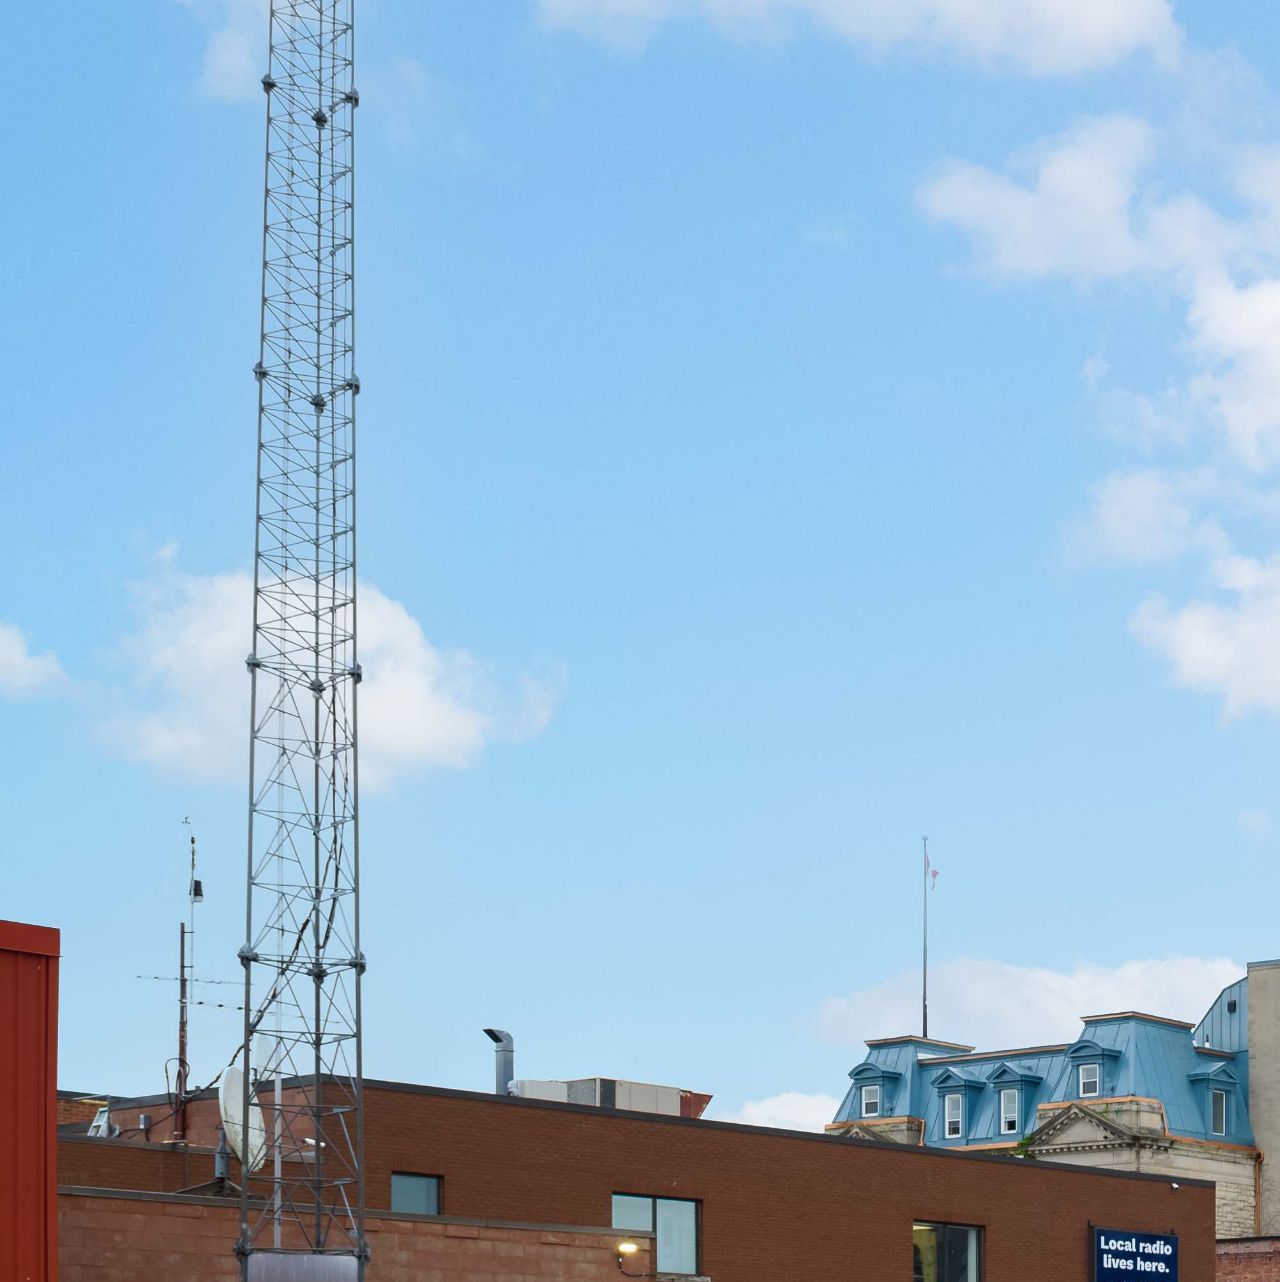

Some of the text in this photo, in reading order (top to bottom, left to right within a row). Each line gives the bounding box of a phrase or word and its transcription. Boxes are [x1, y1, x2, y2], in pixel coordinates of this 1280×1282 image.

[1100, 1236, 1172, 1255] Local radio
[1103, 1254, 1170, 1273] lives here.
